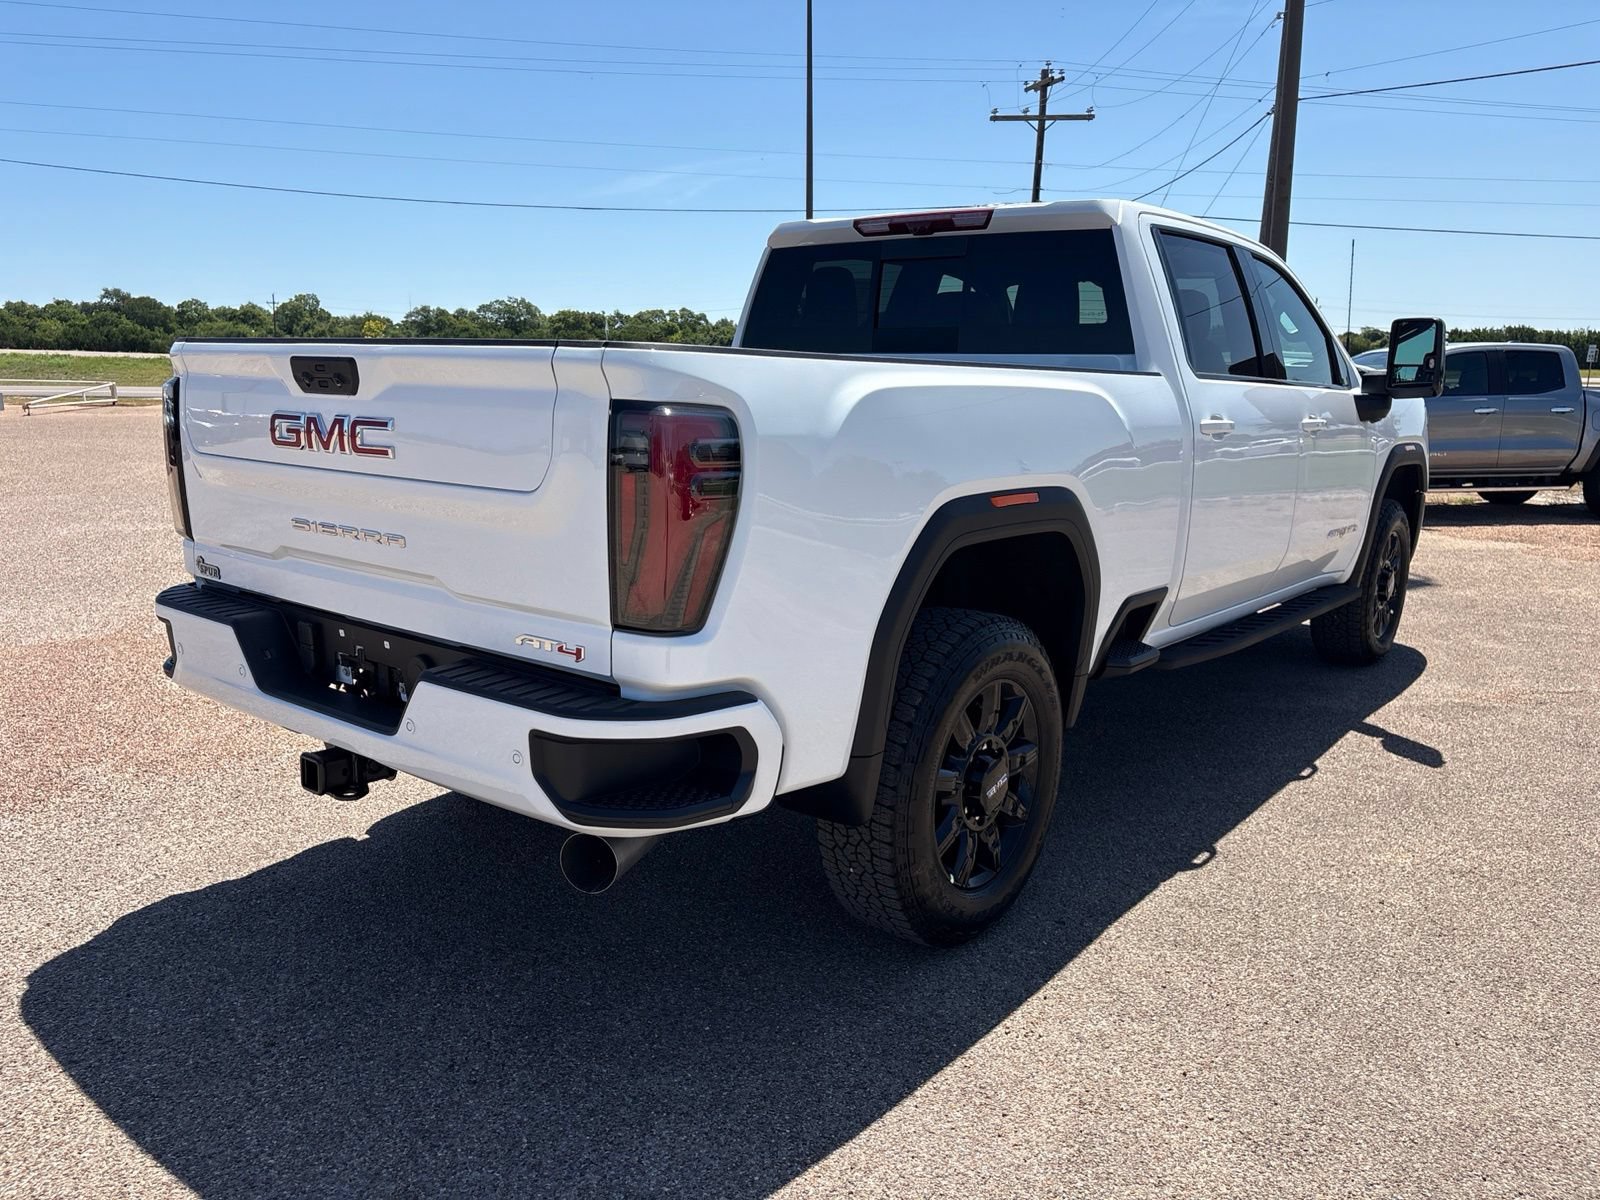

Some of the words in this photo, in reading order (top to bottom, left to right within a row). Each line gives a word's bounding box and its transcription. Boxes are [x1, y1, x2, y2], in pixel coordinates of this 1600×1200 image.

[269, 410, 396, 459] GMC
[291, 517, 407, 549] SIERRA
[199, 564, 219, 578] SPUR
[515, 633, 585, 663] AT4
